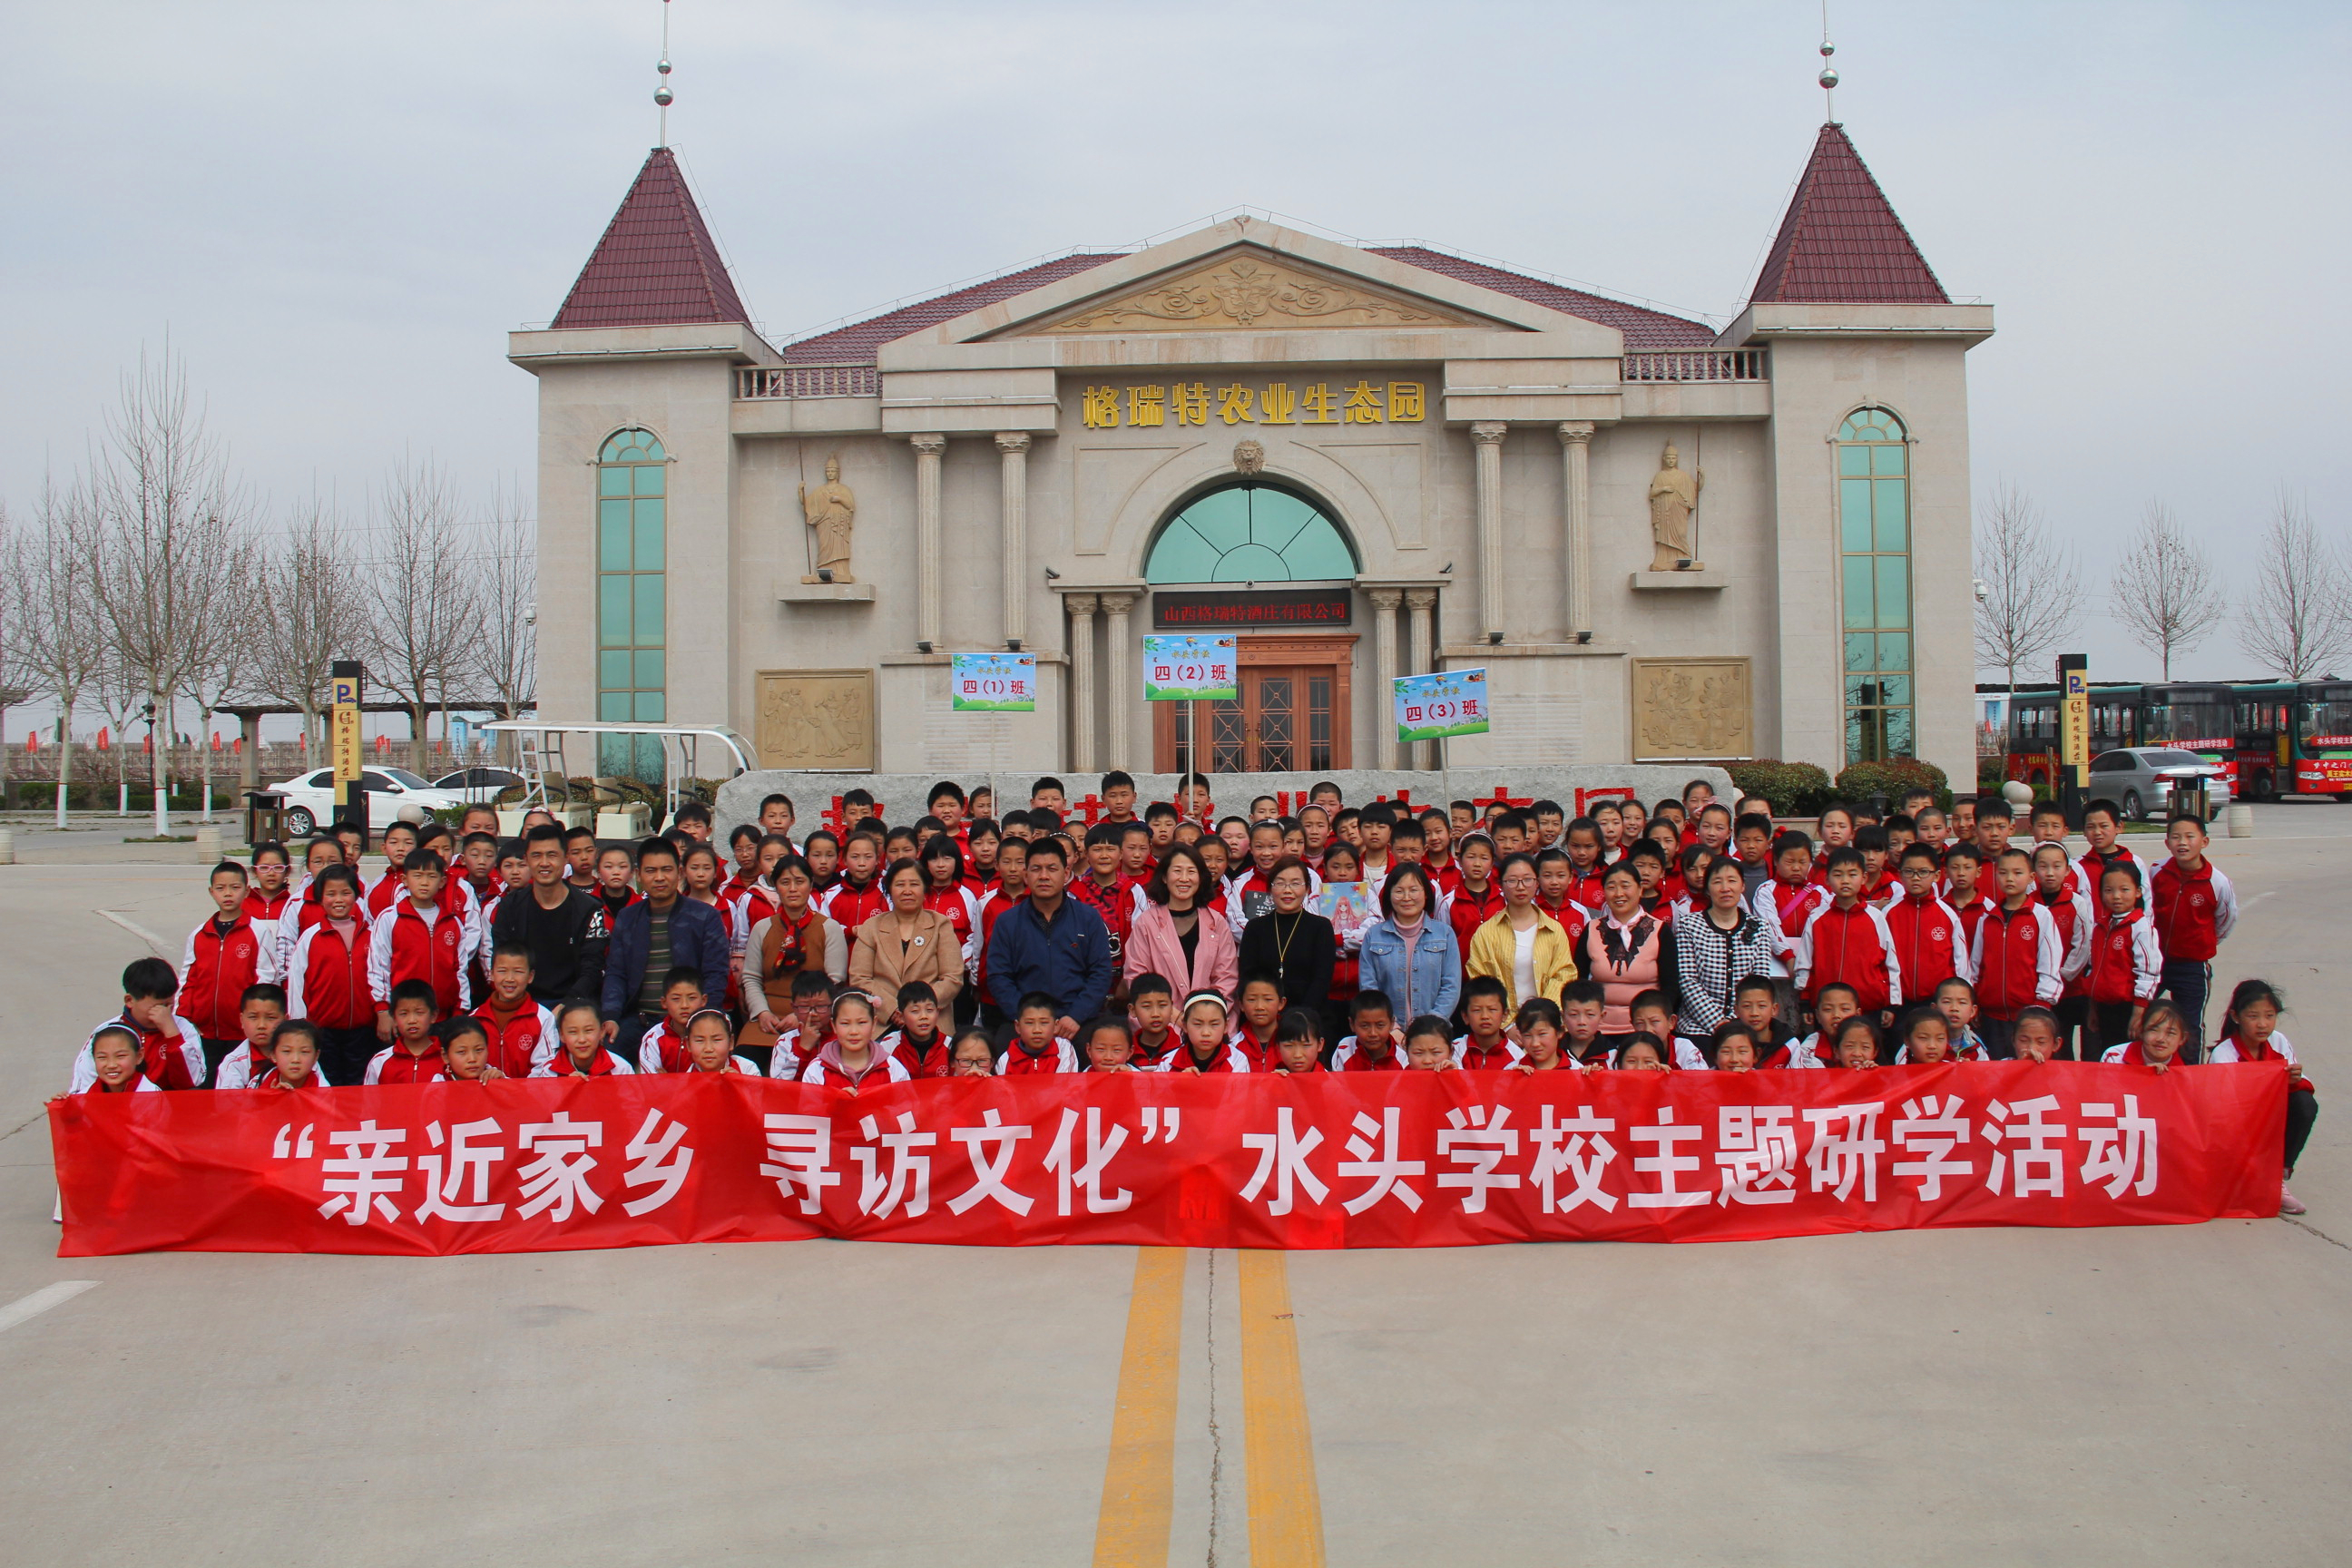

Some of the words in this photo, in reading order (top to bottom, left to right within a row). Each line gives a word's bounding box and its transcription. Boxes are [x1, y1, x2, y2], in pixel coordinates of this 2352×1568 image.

[1083, 380, 1426, 428] 格瑞特农业生态园
[1164, 602, 1347, 622] 山西格瑞特酒庄有限公司
[337, 684, 351, 704] P
[2069, 676, 2082, 694] P
[273, 1108, 693, 1225] “亲近家乡
[760, 1107, 1181, 1220] 寻访文化”
[1240, 1094, 2159, 1216] 水头学校主题研学活动
